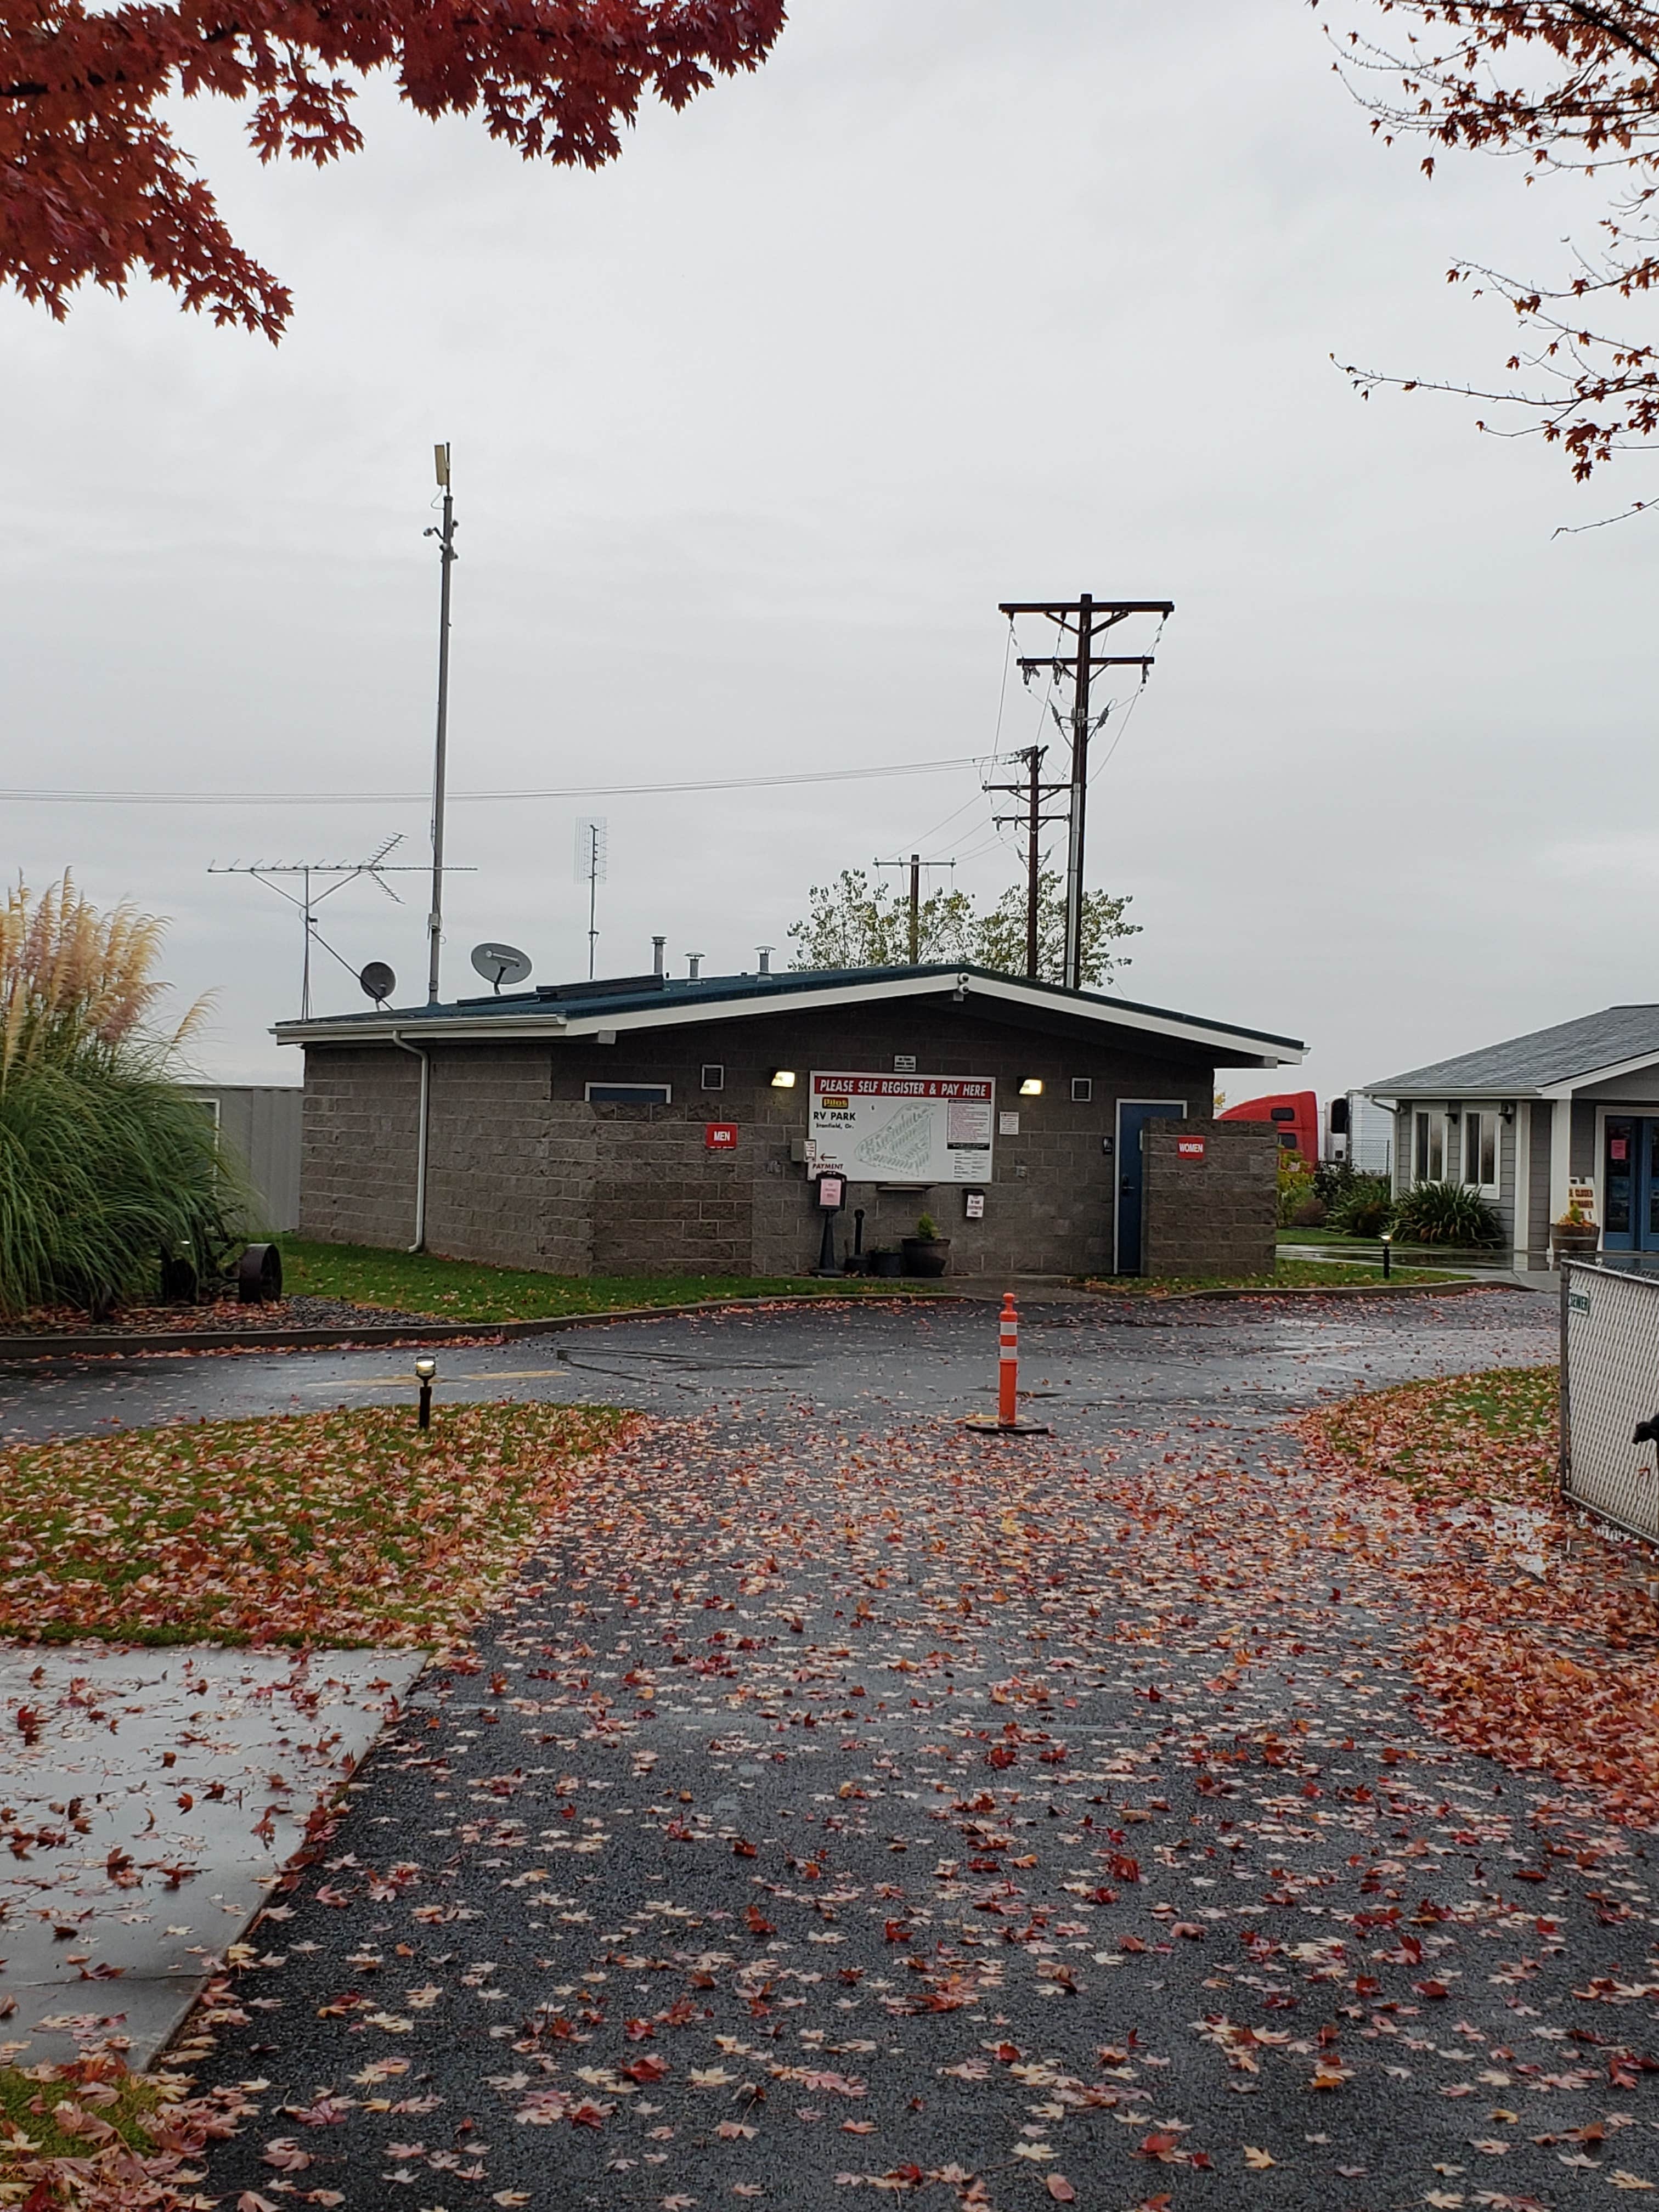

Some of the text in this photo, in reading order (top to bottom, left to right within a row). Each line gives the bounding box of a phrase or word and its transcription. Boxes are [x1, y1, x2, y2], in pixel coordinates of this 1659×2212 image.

[820, 1079, 987, 1097] PLEASE SELF REGISTER & PAY HERE
[813, 1111, 856, 1121] RV PARK
[714, 1131, 730, 1141] MEN
[1178, 1143, 1204, 1153] WOMEN
